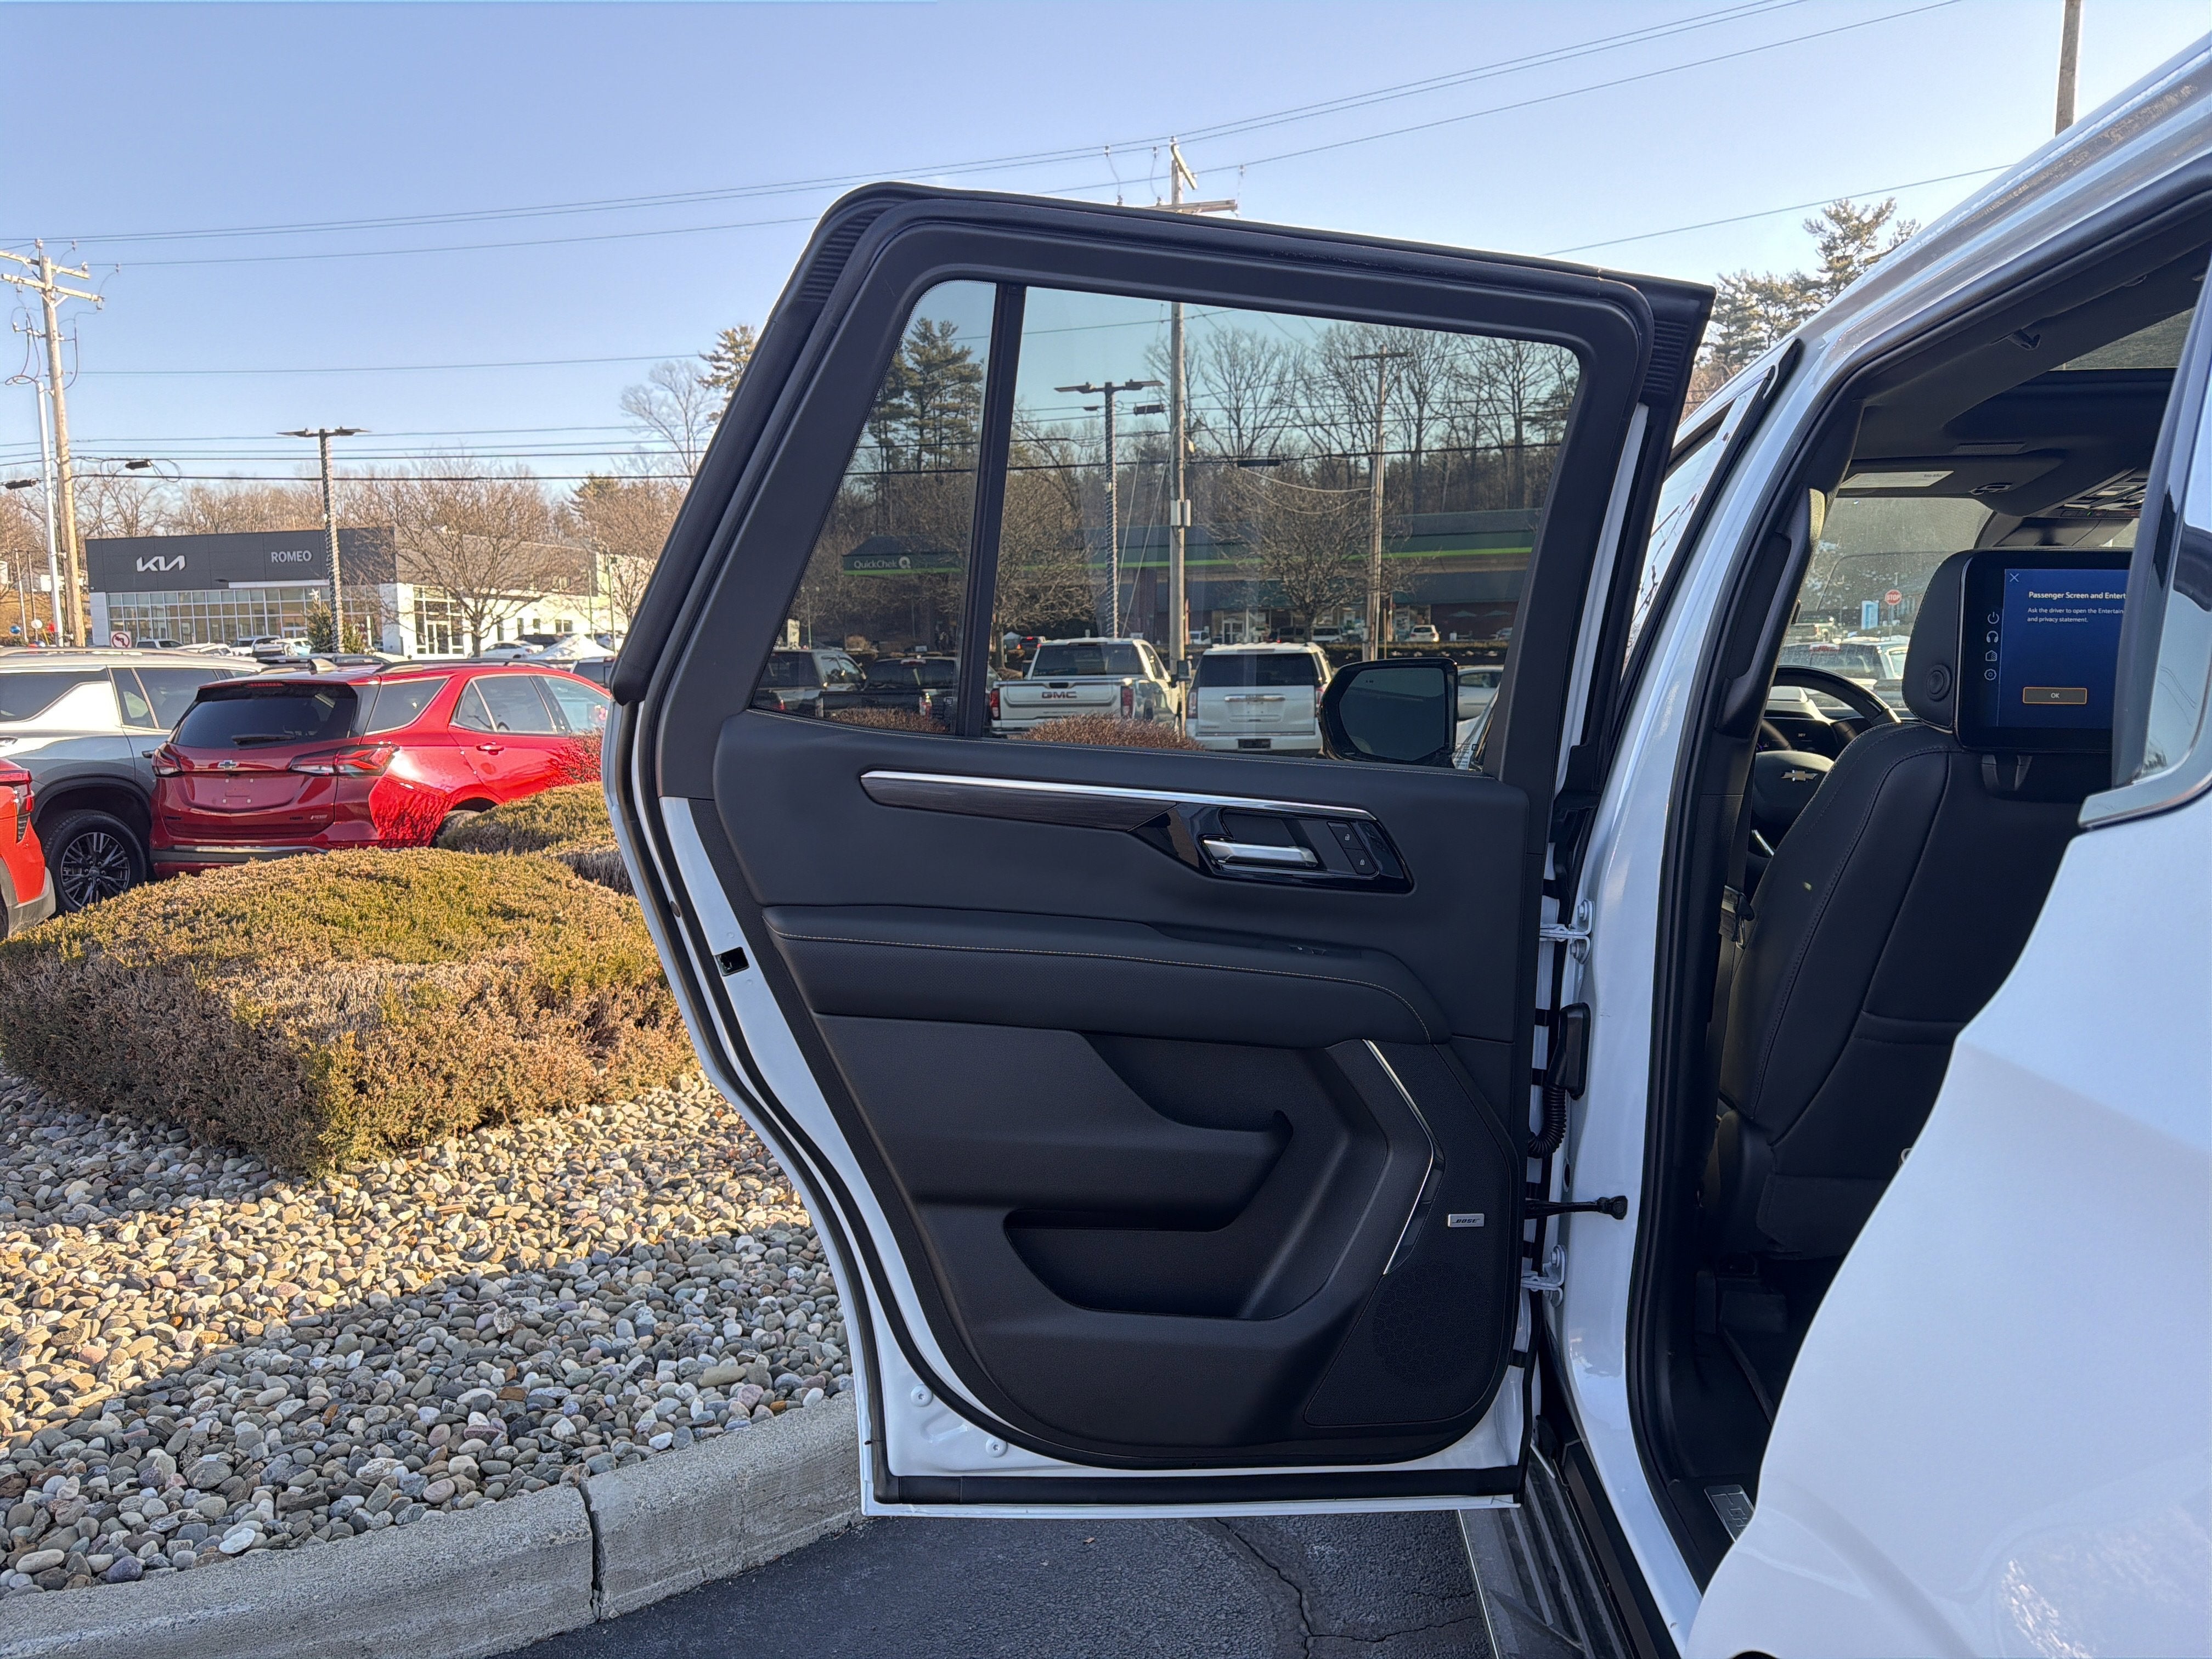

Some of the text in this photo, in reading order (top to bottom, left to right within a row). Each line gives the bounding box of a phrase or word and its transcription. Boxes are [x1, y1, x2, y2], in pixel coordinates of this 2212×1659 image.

[270, 550, 312, 563] ROMEO
[136, 555, 185, 572] KIA
[854, 560, 897, 569] QuickChek
[2029, 591, 2064, 600] Passenger
